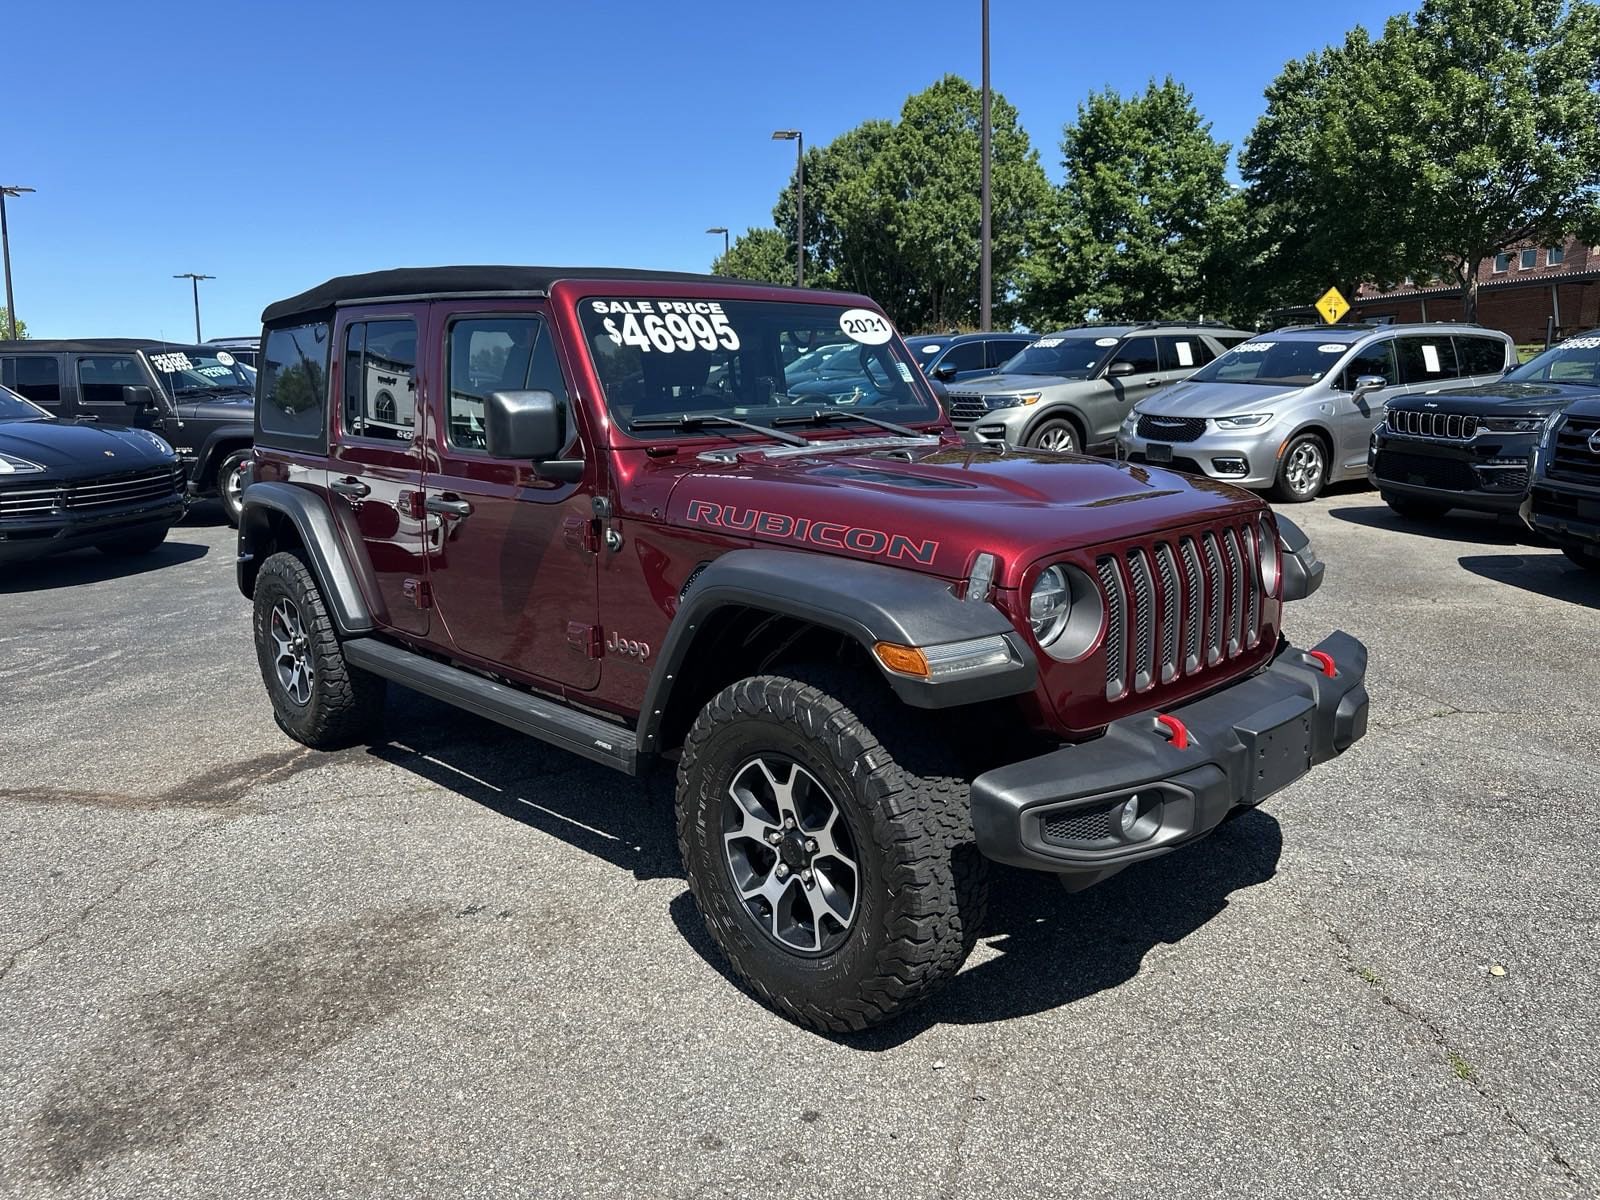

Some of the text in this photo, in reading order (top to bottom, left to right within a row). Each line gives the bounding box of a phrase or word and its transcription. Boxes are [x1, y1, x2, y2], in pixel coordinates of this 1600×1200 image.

[592, 301, 725, 314] SALE PRICE
[603, 313, 740, 354] $46995
[843, 317, 888, 334] 2021
[686, 500, 939, 565] RUBICON
[606, 631, 650, 663] Jeep
